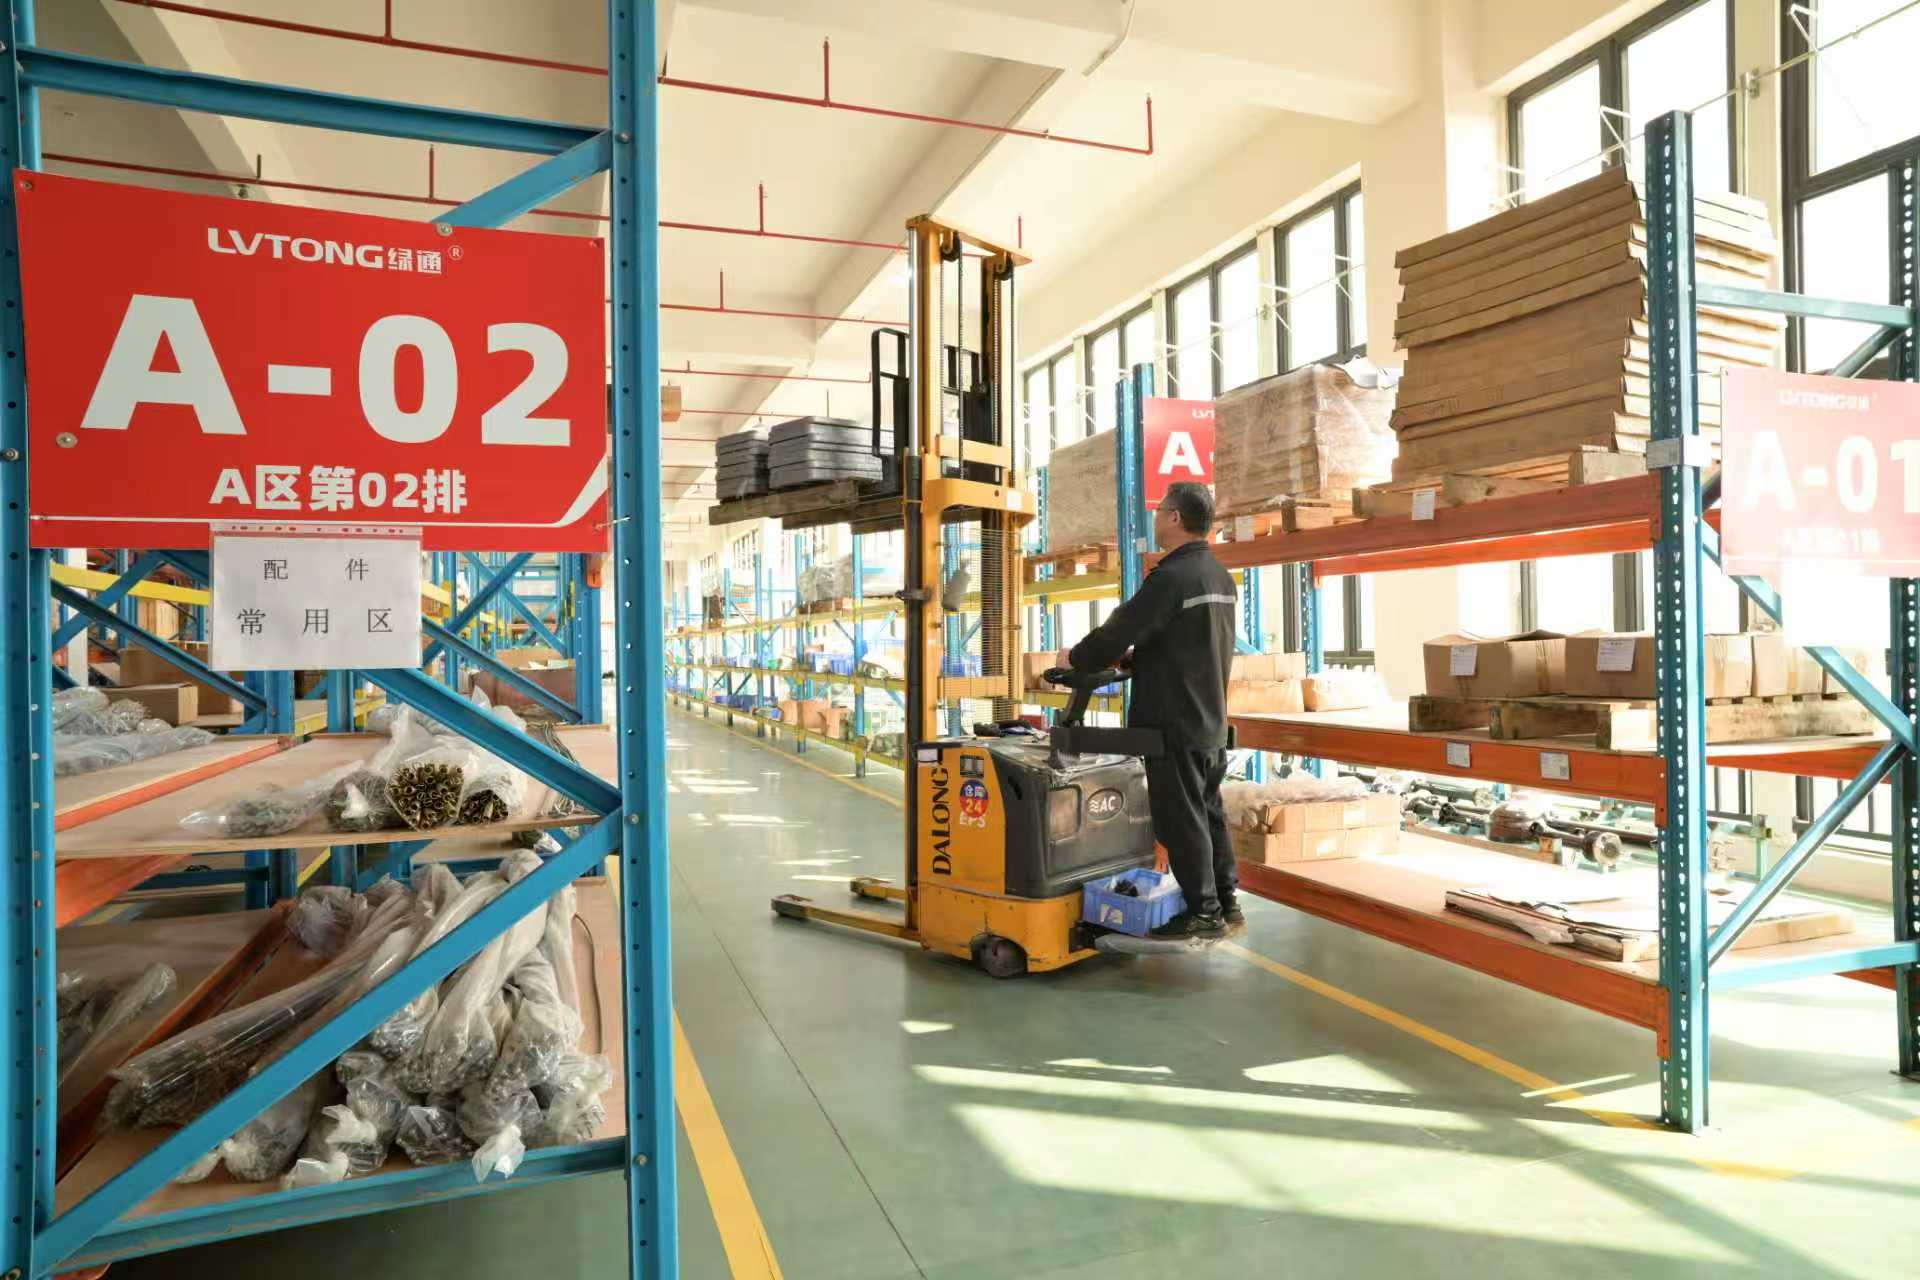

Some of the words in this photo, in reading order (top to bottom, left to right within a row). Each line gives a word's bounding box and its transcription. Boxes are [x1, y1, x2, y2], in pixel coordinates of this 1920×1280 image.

[207, 228, 383, 268] LVTONG
[80, 294, 571, 447] A-02
[1157, 431, 1215, 476] A
[1742, 429, 1920, 514] A-01
[208, 464, 468, 515] A区第02排
[932, 767, 951, 876] DALONG
